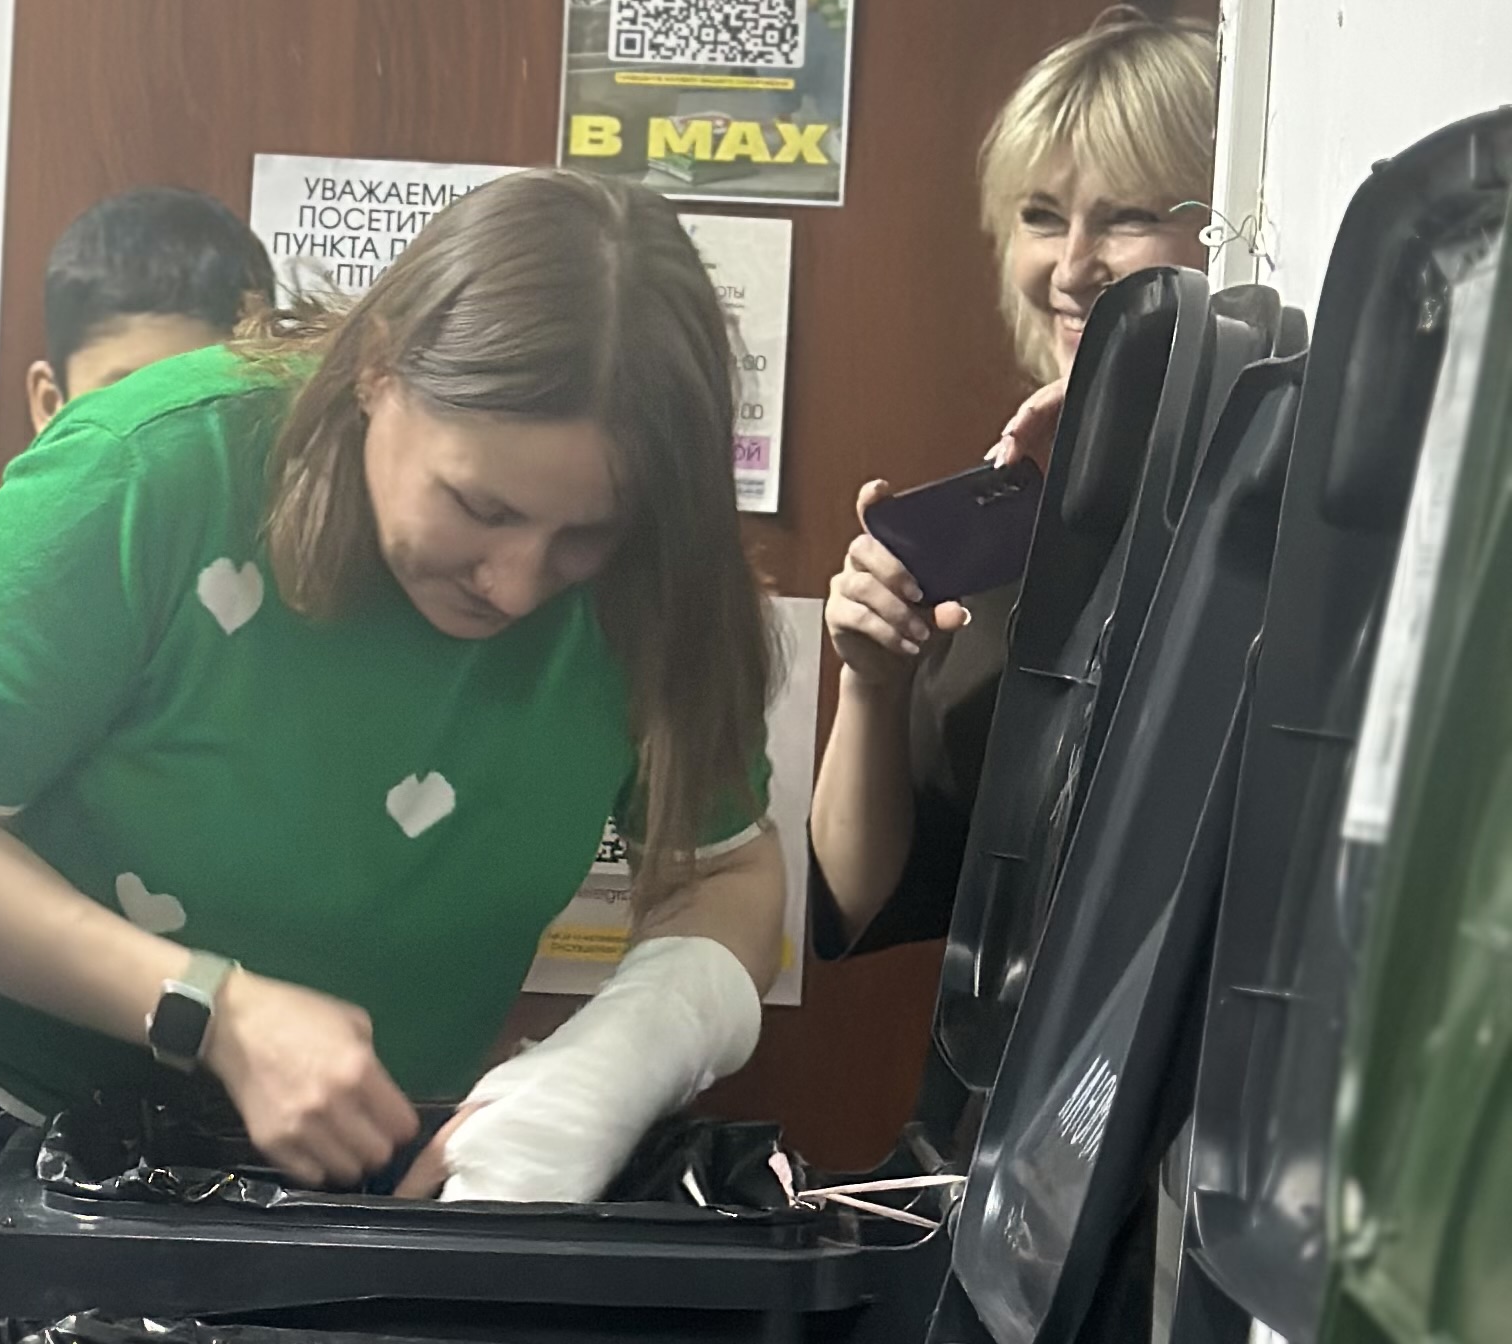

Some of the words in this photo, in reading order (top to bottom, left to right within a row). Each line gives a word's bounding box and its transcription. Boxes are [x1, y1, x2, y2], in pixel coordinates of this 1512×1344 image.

[304, 177, 483, 208] УВАЖАЕМЫ
[299, 205, 439, 234] ПОСЕТИТ
[273, 232, 379, 260] ПУНКТА
